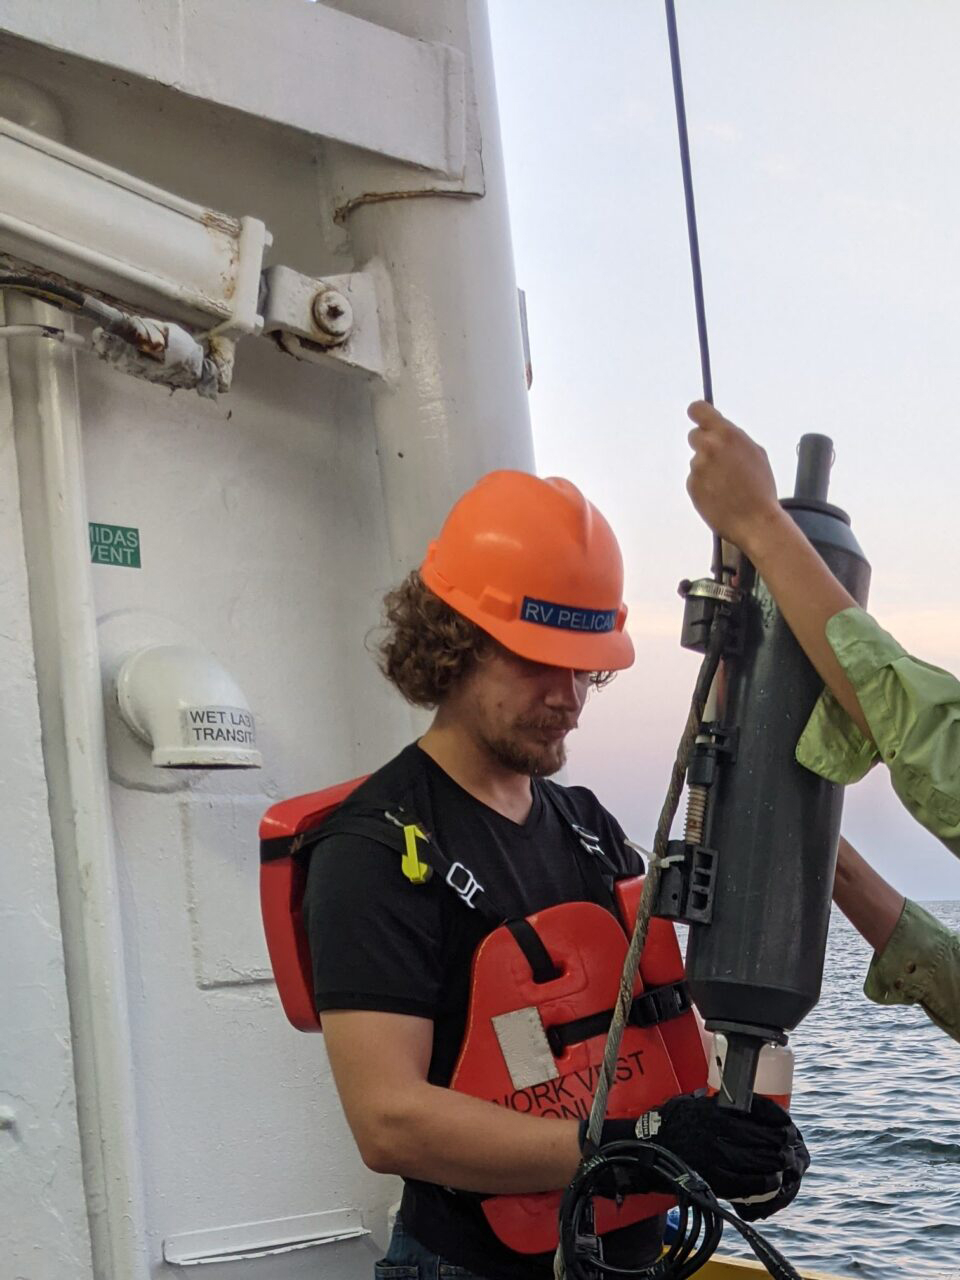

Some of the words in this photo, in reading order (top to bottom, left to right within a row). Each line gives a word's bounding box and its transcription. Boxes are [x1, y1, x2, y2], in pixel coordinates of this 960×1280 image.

[89, 526, 138, 548] IDAS
[525, 603, 553, 623] RV
[189, 710, 226, 724] WET
[574, 1050, 645, 1093] VST
